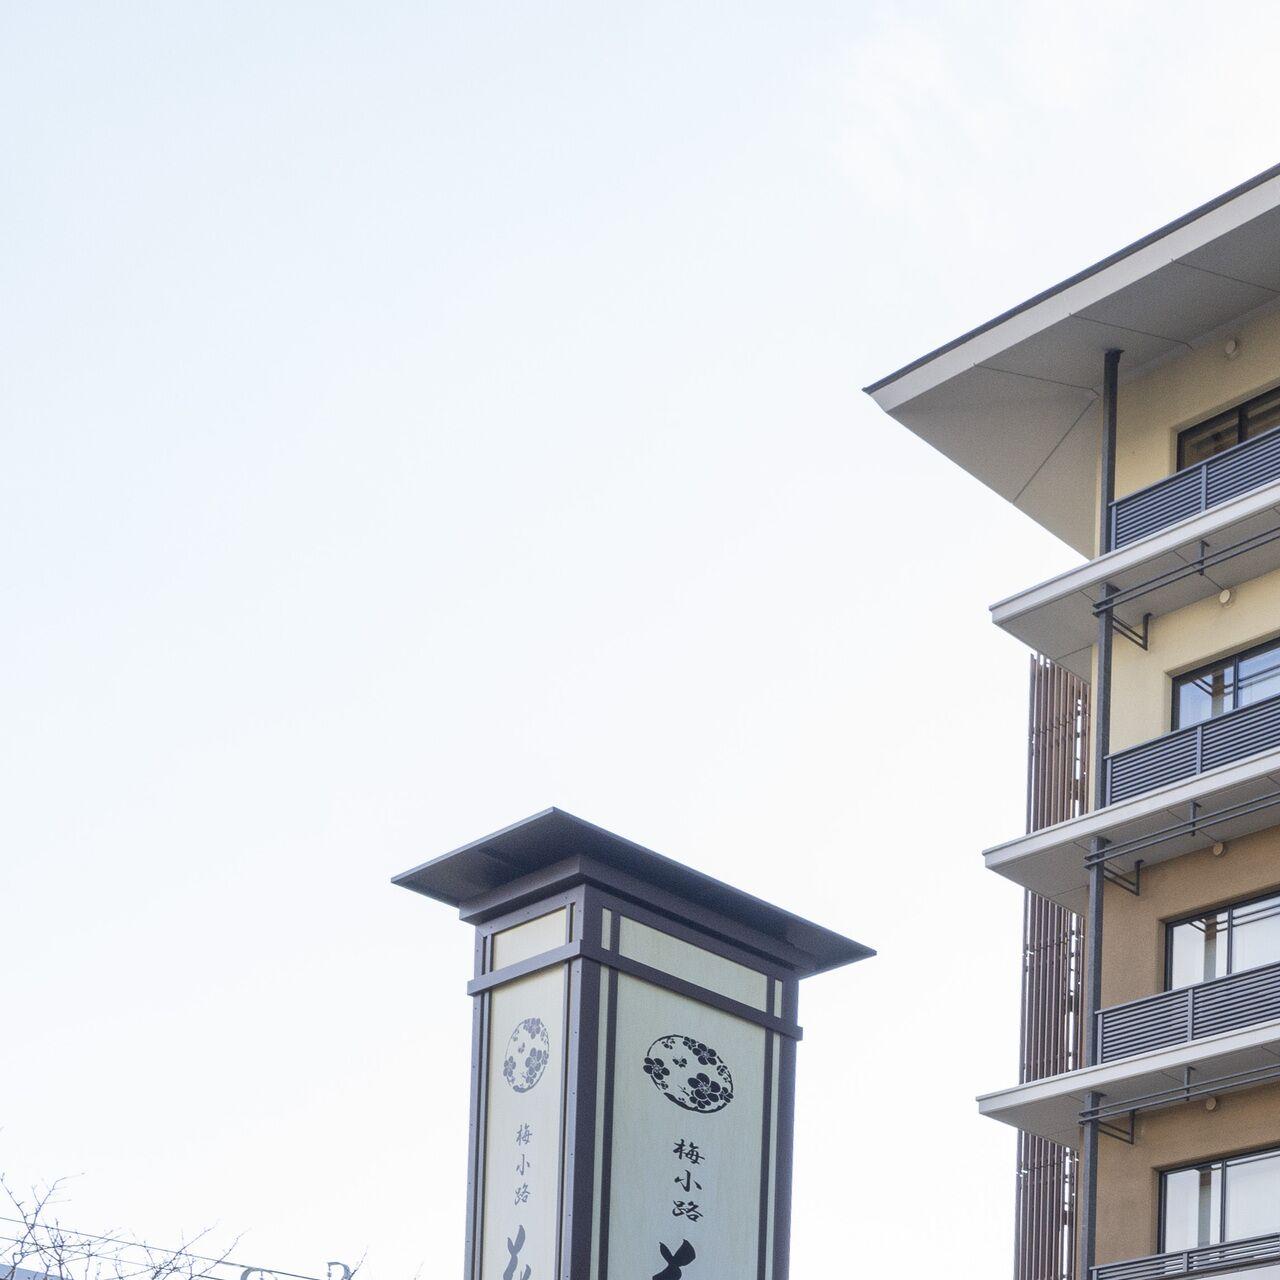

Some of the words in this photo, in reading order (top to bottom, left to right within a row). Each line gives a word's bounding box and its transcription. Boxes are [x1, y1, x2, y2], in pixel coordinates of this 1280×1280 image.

[514, 1122, 534, 1207] 梅小路
[672, 1138, 707, 1223] 梅小路
